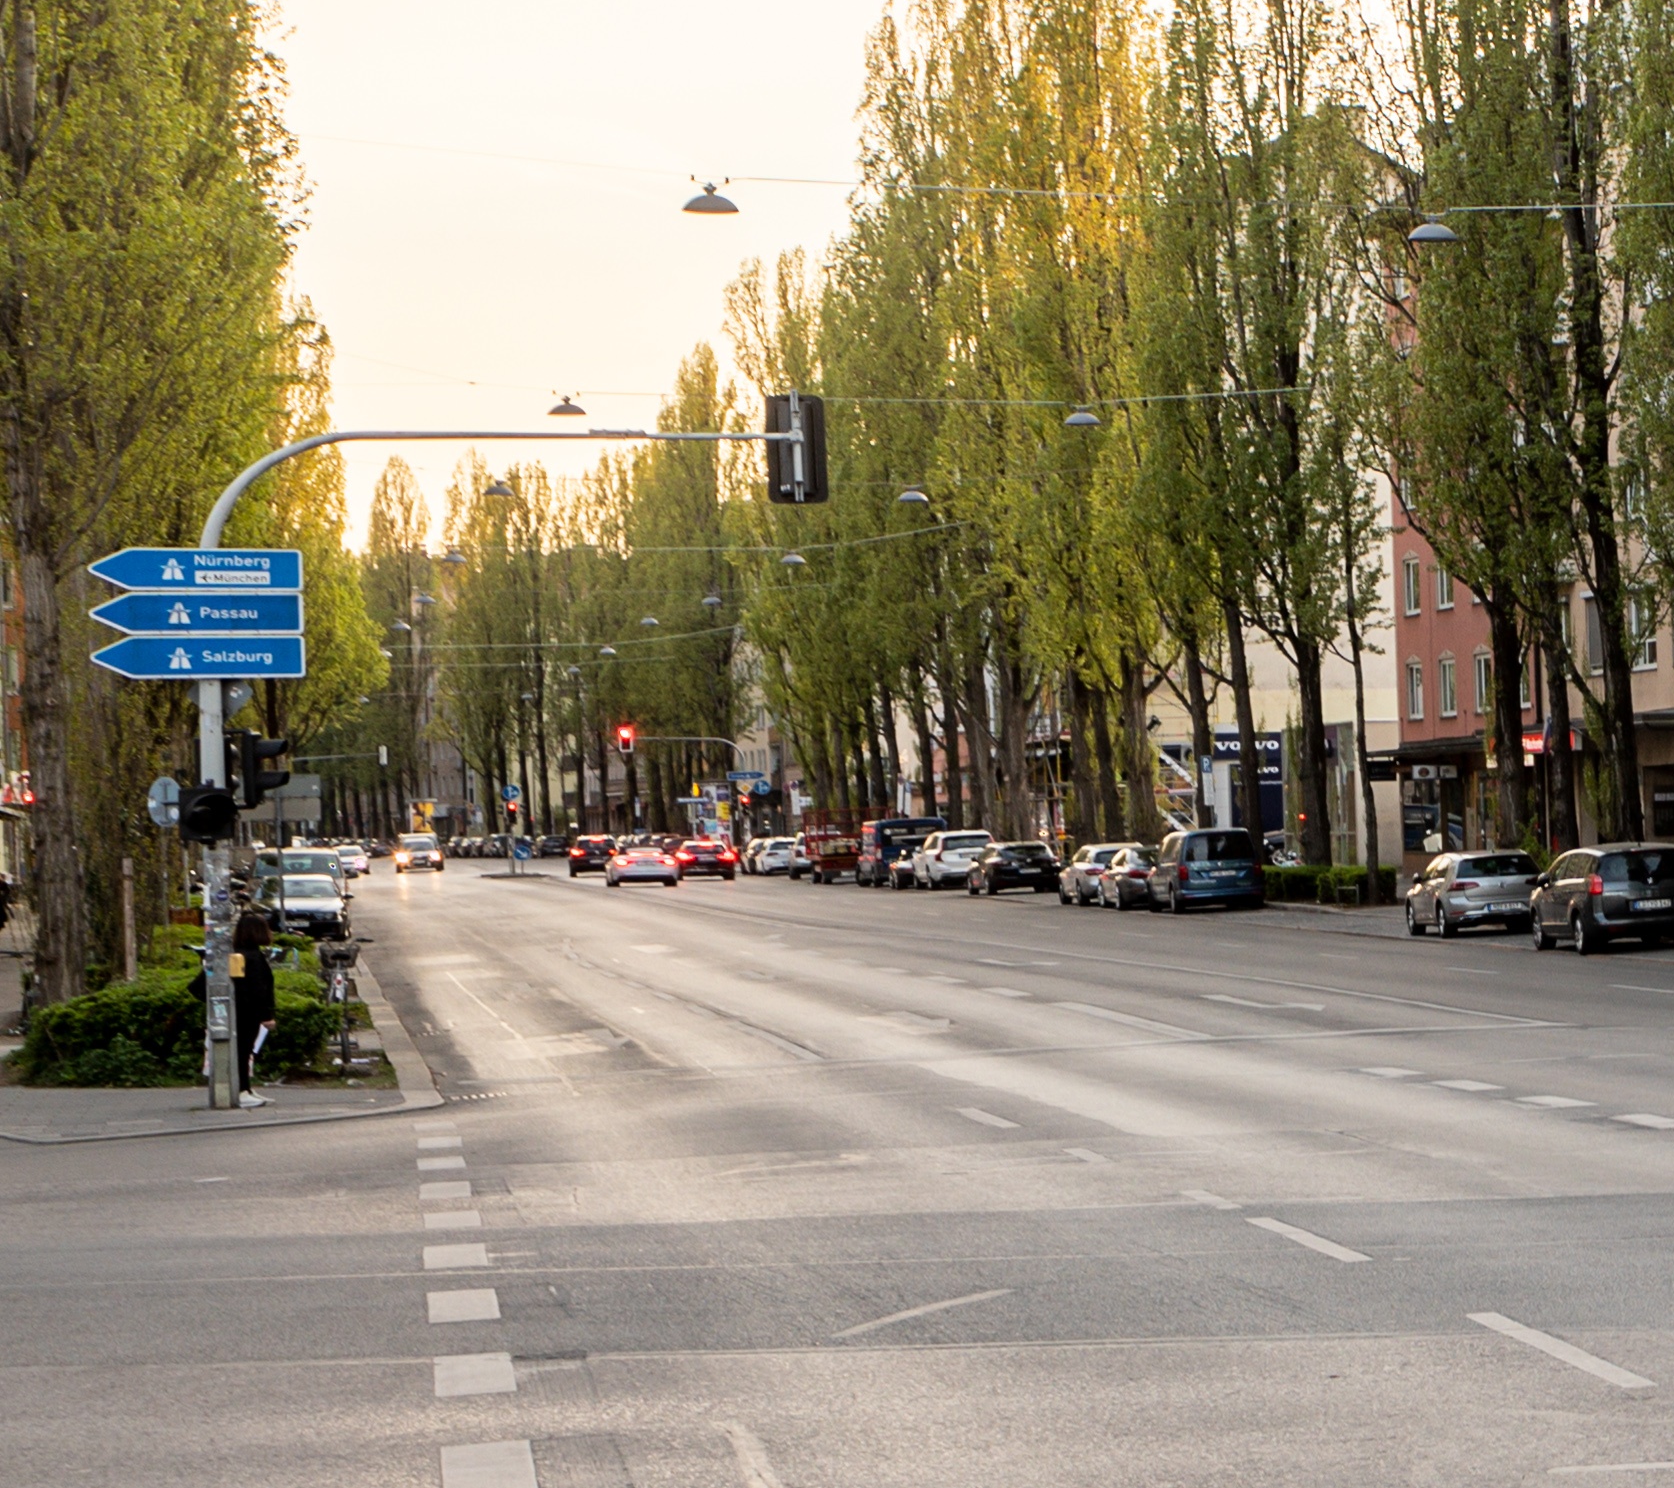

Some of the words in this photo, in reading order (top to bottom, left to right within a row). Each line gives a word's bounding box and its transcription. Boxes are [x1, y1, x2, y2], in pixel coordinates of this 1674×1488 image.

[194, 555, 270, 569] Nürnberg
[213, 572, 268, 583] München
[200, 607, 258, 619] Passau
[202, 651, 273, 664] Salzburg
[1215, 740, 1280, 751] VOVO
